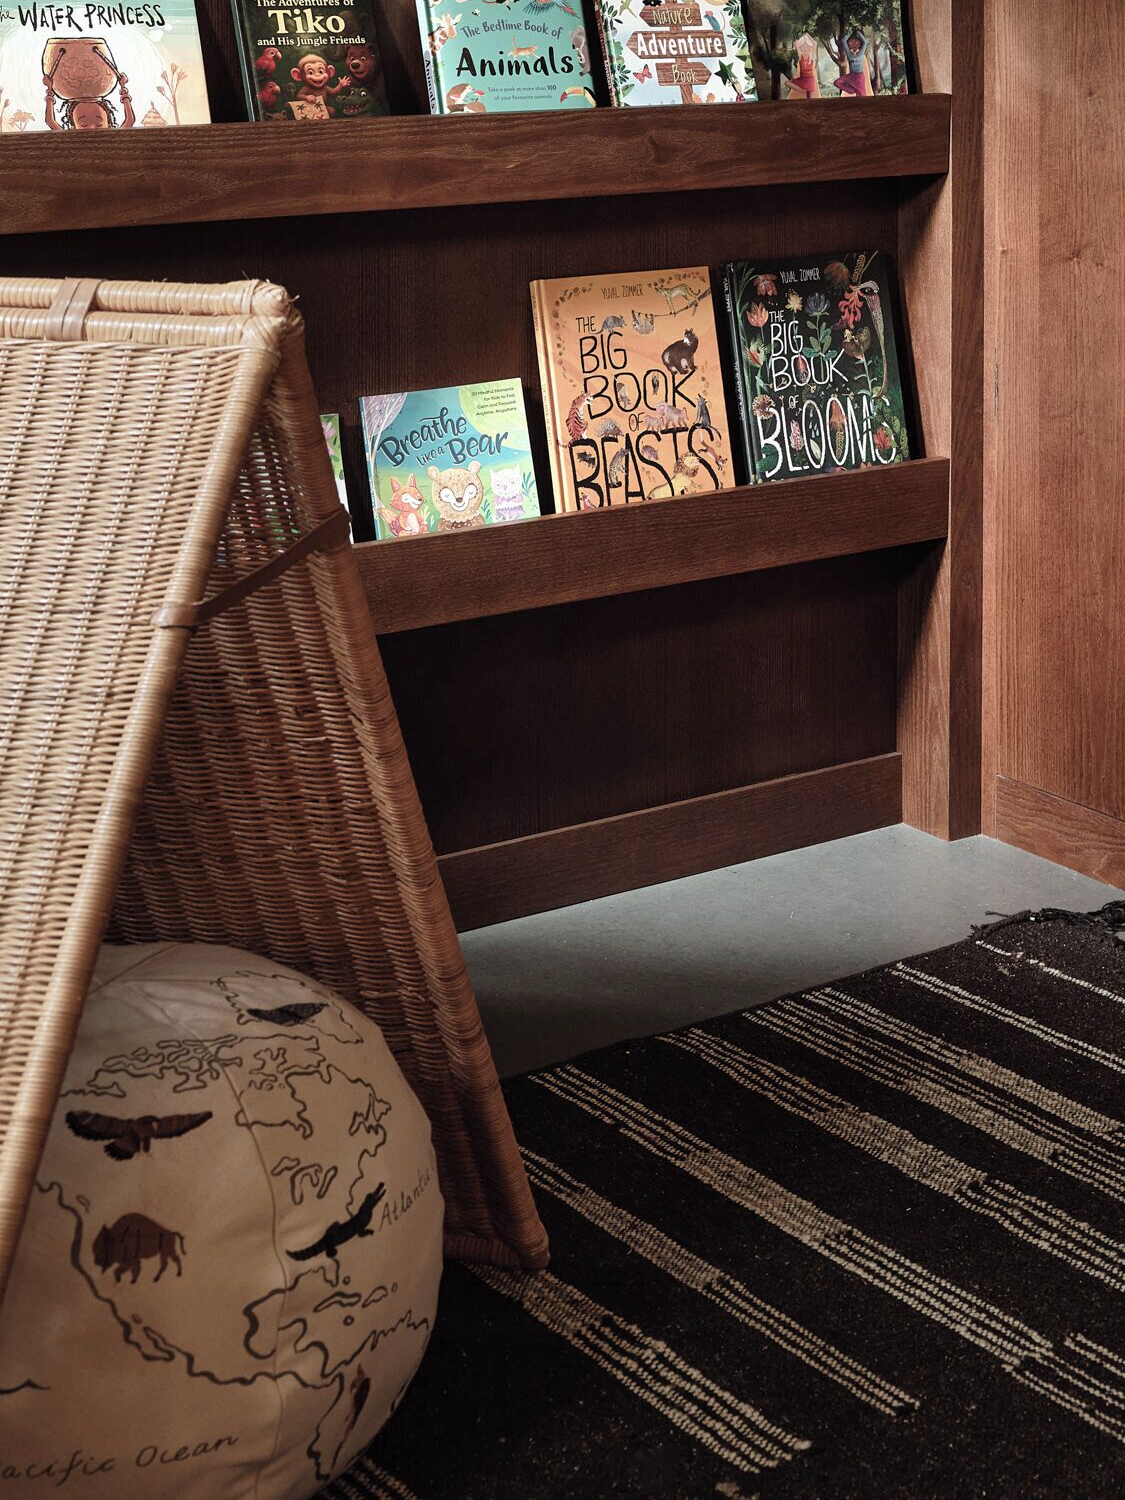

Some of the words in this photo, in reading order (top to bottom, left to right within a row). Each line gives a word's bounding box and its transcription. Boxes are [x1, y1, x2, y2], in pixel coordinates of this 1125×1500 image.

[0, 5, 15, 23] he
[18, 1, 83, 32] WATER
[84, 3, 166, 29] PRINCESS
[267, 8, 346, 34] Tiko
[460, 24, 480, 39] The
[482, 19, 522, 33] Bedtime
[524, 20, 549, 34] Book
[551, 26, 564, 39] of
[653, 8, 693, 25] Nature
[257, 37, 276, 46] and
[277, 36, 295, 46] His
[296, 36, 328, 47] Jungle
[329, 35, 366, 45] Friends
[637, 33, 723, 56] Adventure
[456, 46, 574, 78] Animals
[671, 64, 698, 83] Book
[425, 59, 436, 110] Animals
[780, 268, 798, 285] YUVAL
[799, 267, 821, 283] ZOMMER
[601, 285, 620, 300] YUVAL
[621, 283, 644, 299] ZOMMER
[576, 316, 596, 334] THE
[769, 310, 786, 324] THE
[770, 320, 804, 358] BIG
[579, 331, 628, 374] BIG
[771, 348, 849, 392] BOOK
[583, 368, 697, 421] BOOK
[787, 394, 799, 410] OF
[628, 412, 644, 432] OF
[377, 406, 467, 467] Breathe
[437, 446, 446, 456] a
[444, 431, 509, 466] Bear
[568, 423, 722, 512] BEASTS
[0, 1449, 115, 1486] acific
[135, 1436, 239, 1468] Ocean
